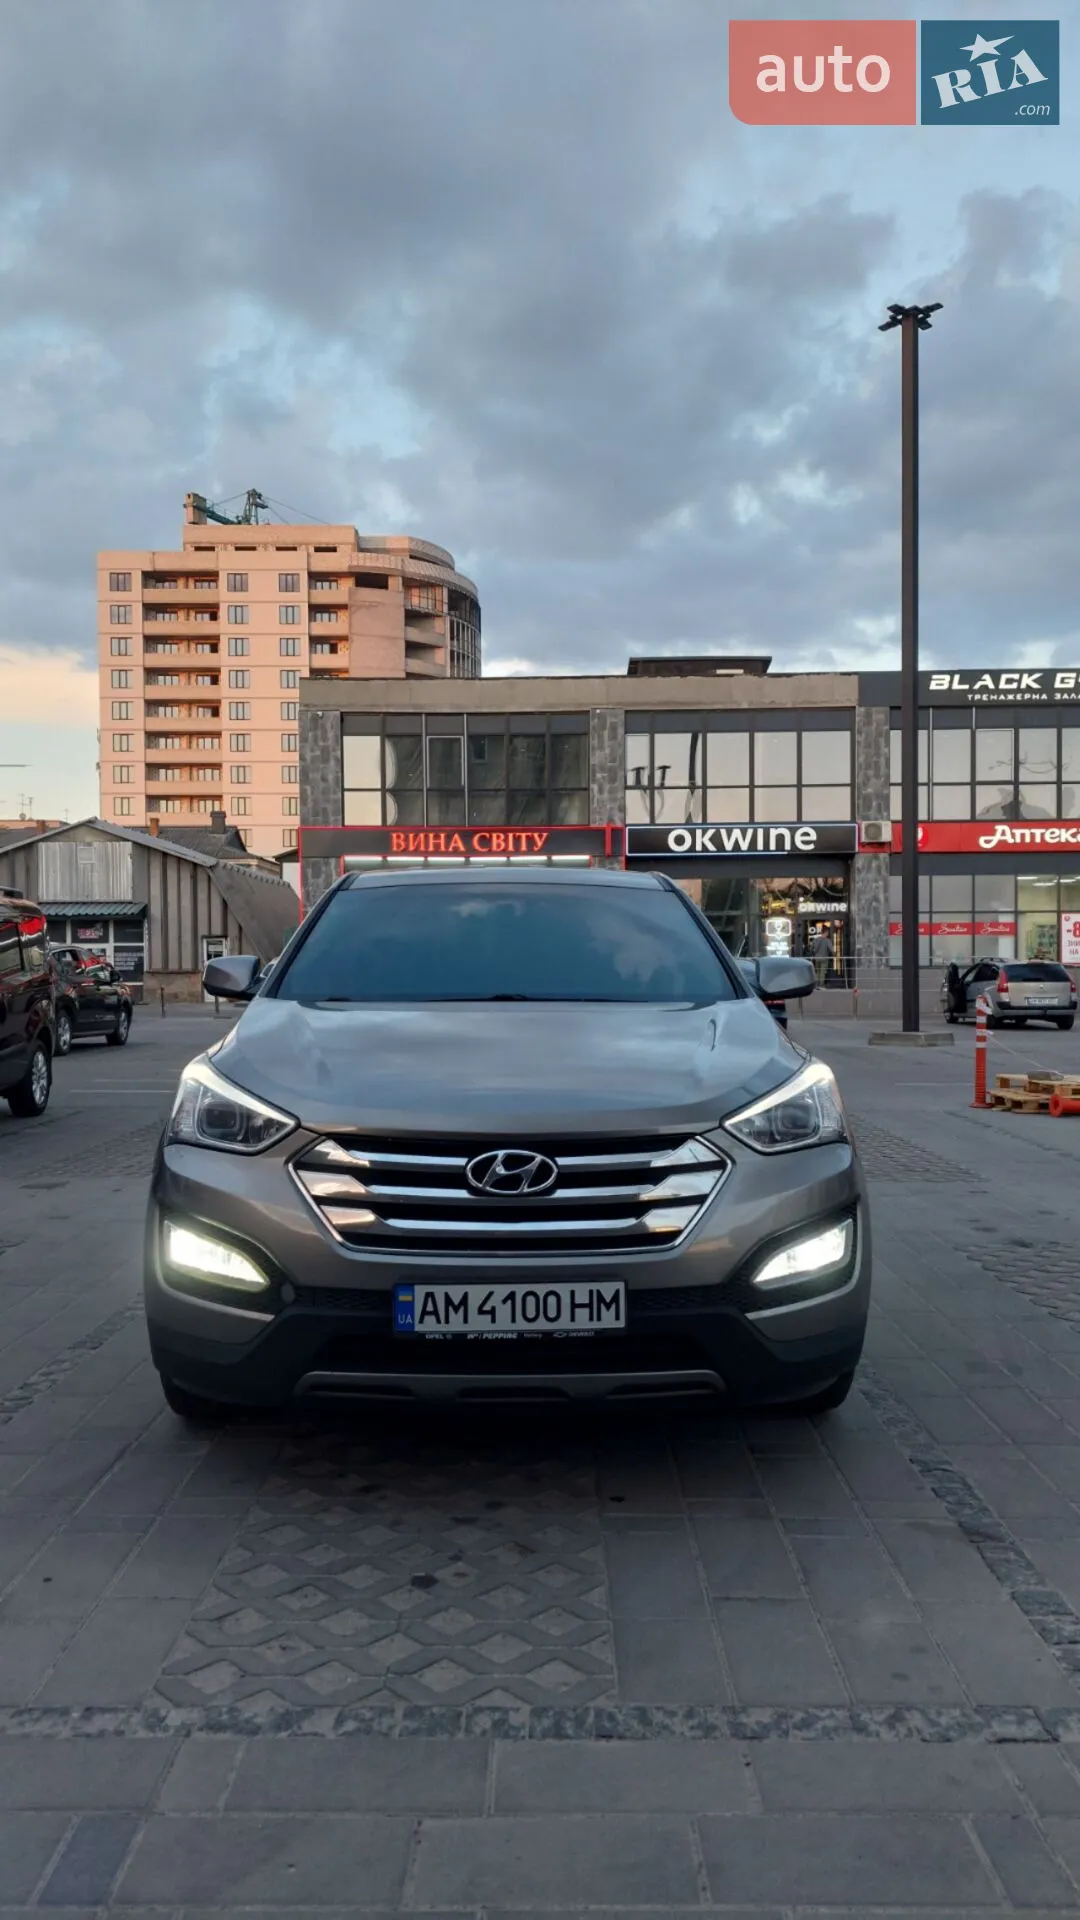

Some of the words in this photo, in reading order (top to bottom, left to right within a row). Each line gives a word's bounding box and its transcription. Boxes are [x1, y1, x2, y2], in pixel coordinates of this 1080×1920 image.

[929, 673, 1043, 690] BLACK
[1053, 672, 1080, 689] G
[967, 693, 1048, 701] ТРЕНАЖЕРНА
[391, 832, 465, 852] ВИНА
[473, 832, 549, 852] СВІТУ
[978, 824, 1080, 848] Аптек
[398, 1313, 413, 1324] UA
